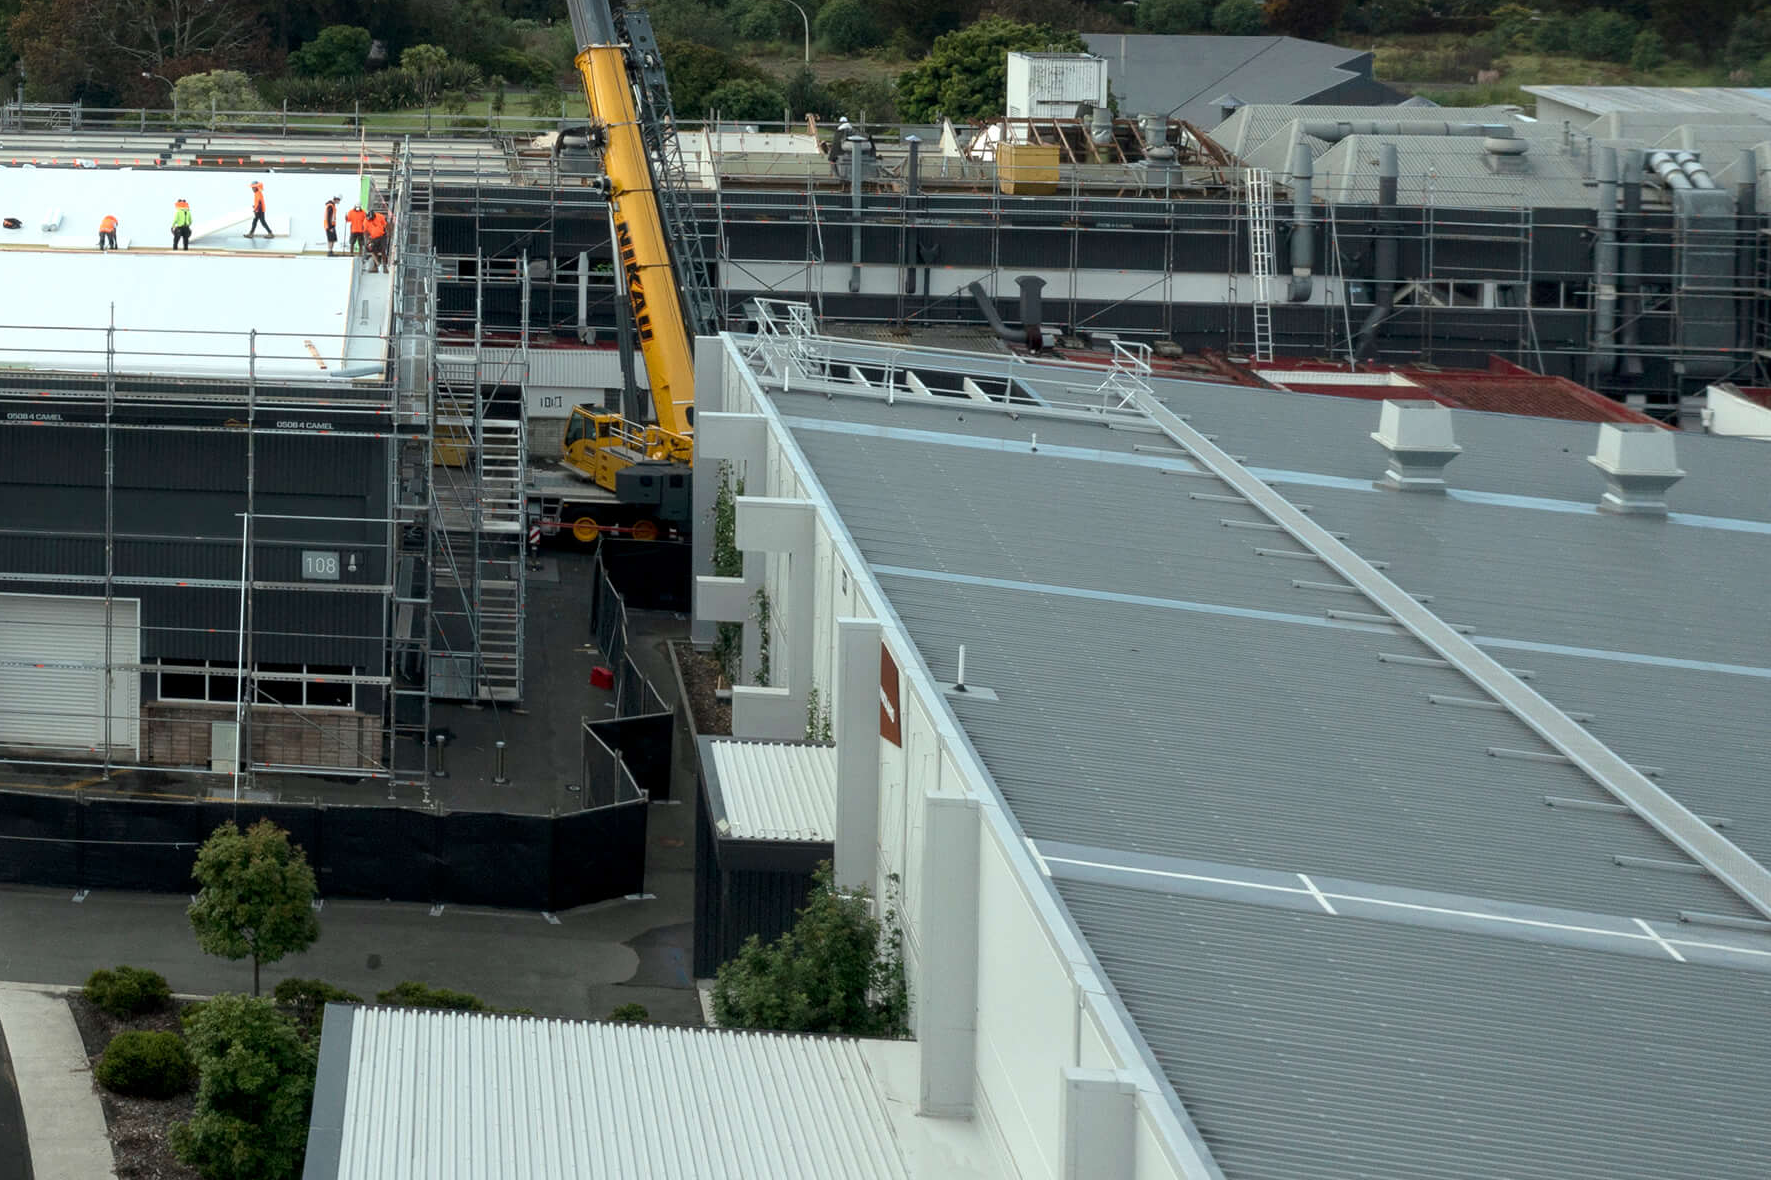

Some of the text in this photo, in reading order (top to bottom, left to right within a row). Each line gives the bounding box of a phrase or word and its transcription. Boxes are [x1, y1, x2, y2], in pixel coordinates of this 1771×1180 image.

[616, 220, 654, 342] NIKAU
[6, 412, 28, 420] 0508
[35, 413, 63, 421] CAMEL
[276, 421, 298, 429] 0508
[305, 422, 334, 430] CAMEL
[306, 557, 336, 574] 108
